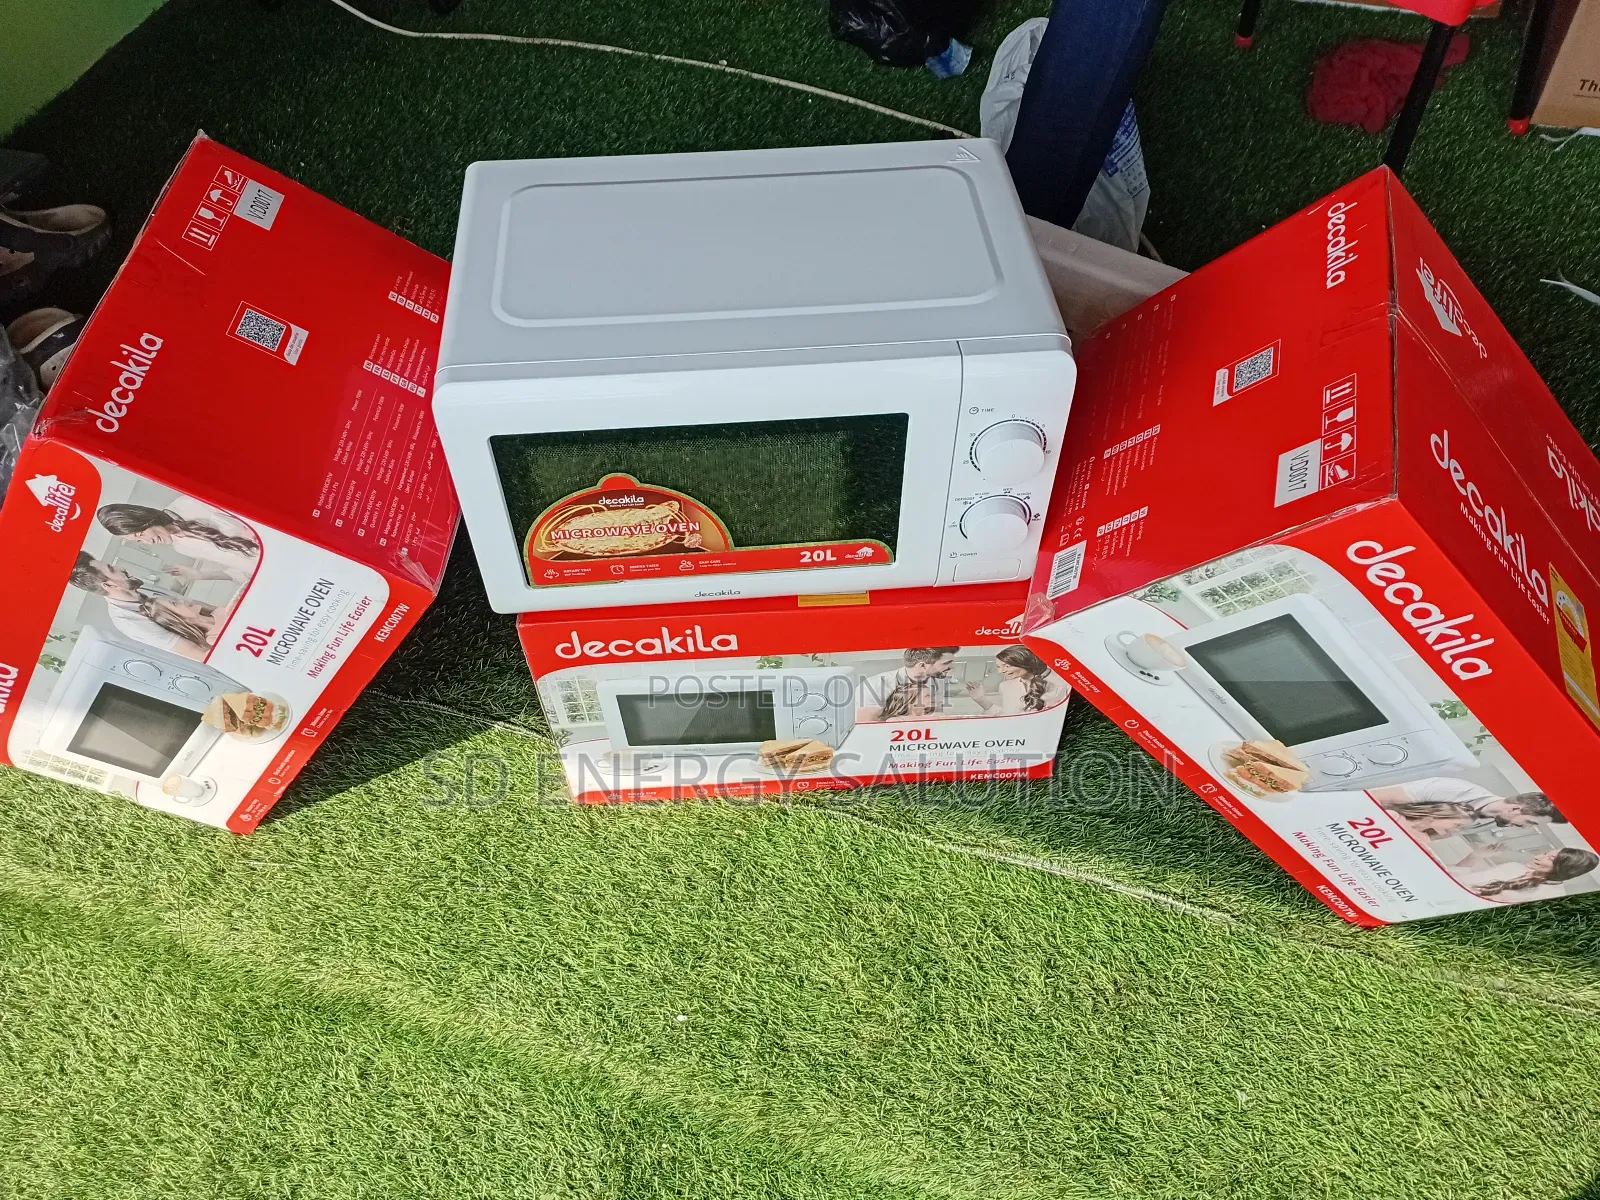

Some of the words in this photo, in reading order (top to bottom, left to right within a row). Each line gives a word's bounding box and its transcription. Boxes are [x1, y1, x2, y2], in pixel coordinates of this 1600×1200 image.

[1580, 79, 1600, 92] Th
[1325, 202, 1356, 289] decakila
[96, 332, 164, 433] decakila
[599, 495, 644, 505] decakila
[551, 524, 652, 540] MICROWAVE
[656, 521, 700, 533] OVEN
[1429, 429, 1549, 608] decakila
[800, 549, 837, 562] 20L
[1460, 502, 1492, 551] Making
[1494, 545, 1509, 571] Fun
[1511, 567, 1526, 593] Life
[1527, 590, 1550, 624] Easier
[694, 590, 741, 598] decakila
[1347, 540, 1494, 681] decakila
[266, 605, 315, 665] MICROWAVE
[303, 576, 334, 608] OVEN
[307, 650, 336, 678] Making
[326, 636, 343, 651] Fun
[337, 620, 357, 636] Life
[349, 594, 372, 620] Easier
[373, 602, 409, 643] KEMC007W
[236, 626, 276, 658] 20L
[555, 625, 738, 659] decakila
[890, 728, 938, 742] 20L
[890, 741, 980, 752] MICROWAVE
[984, 739, 1026, 748] OVEN
[889, 761, 932, 769] Making
[1346, 815, 1393, 850] 20L
[1291, 830, 1326, 859] Making
[1323, 857, 1341, 872] Fun
[1338, 871, 1357, 883] Life
[1353, 885, 1379, 908] Easier
[1325, 822, 1392, 877] MICROWAVE
[1385, 878, 1418, 903] OVEN
